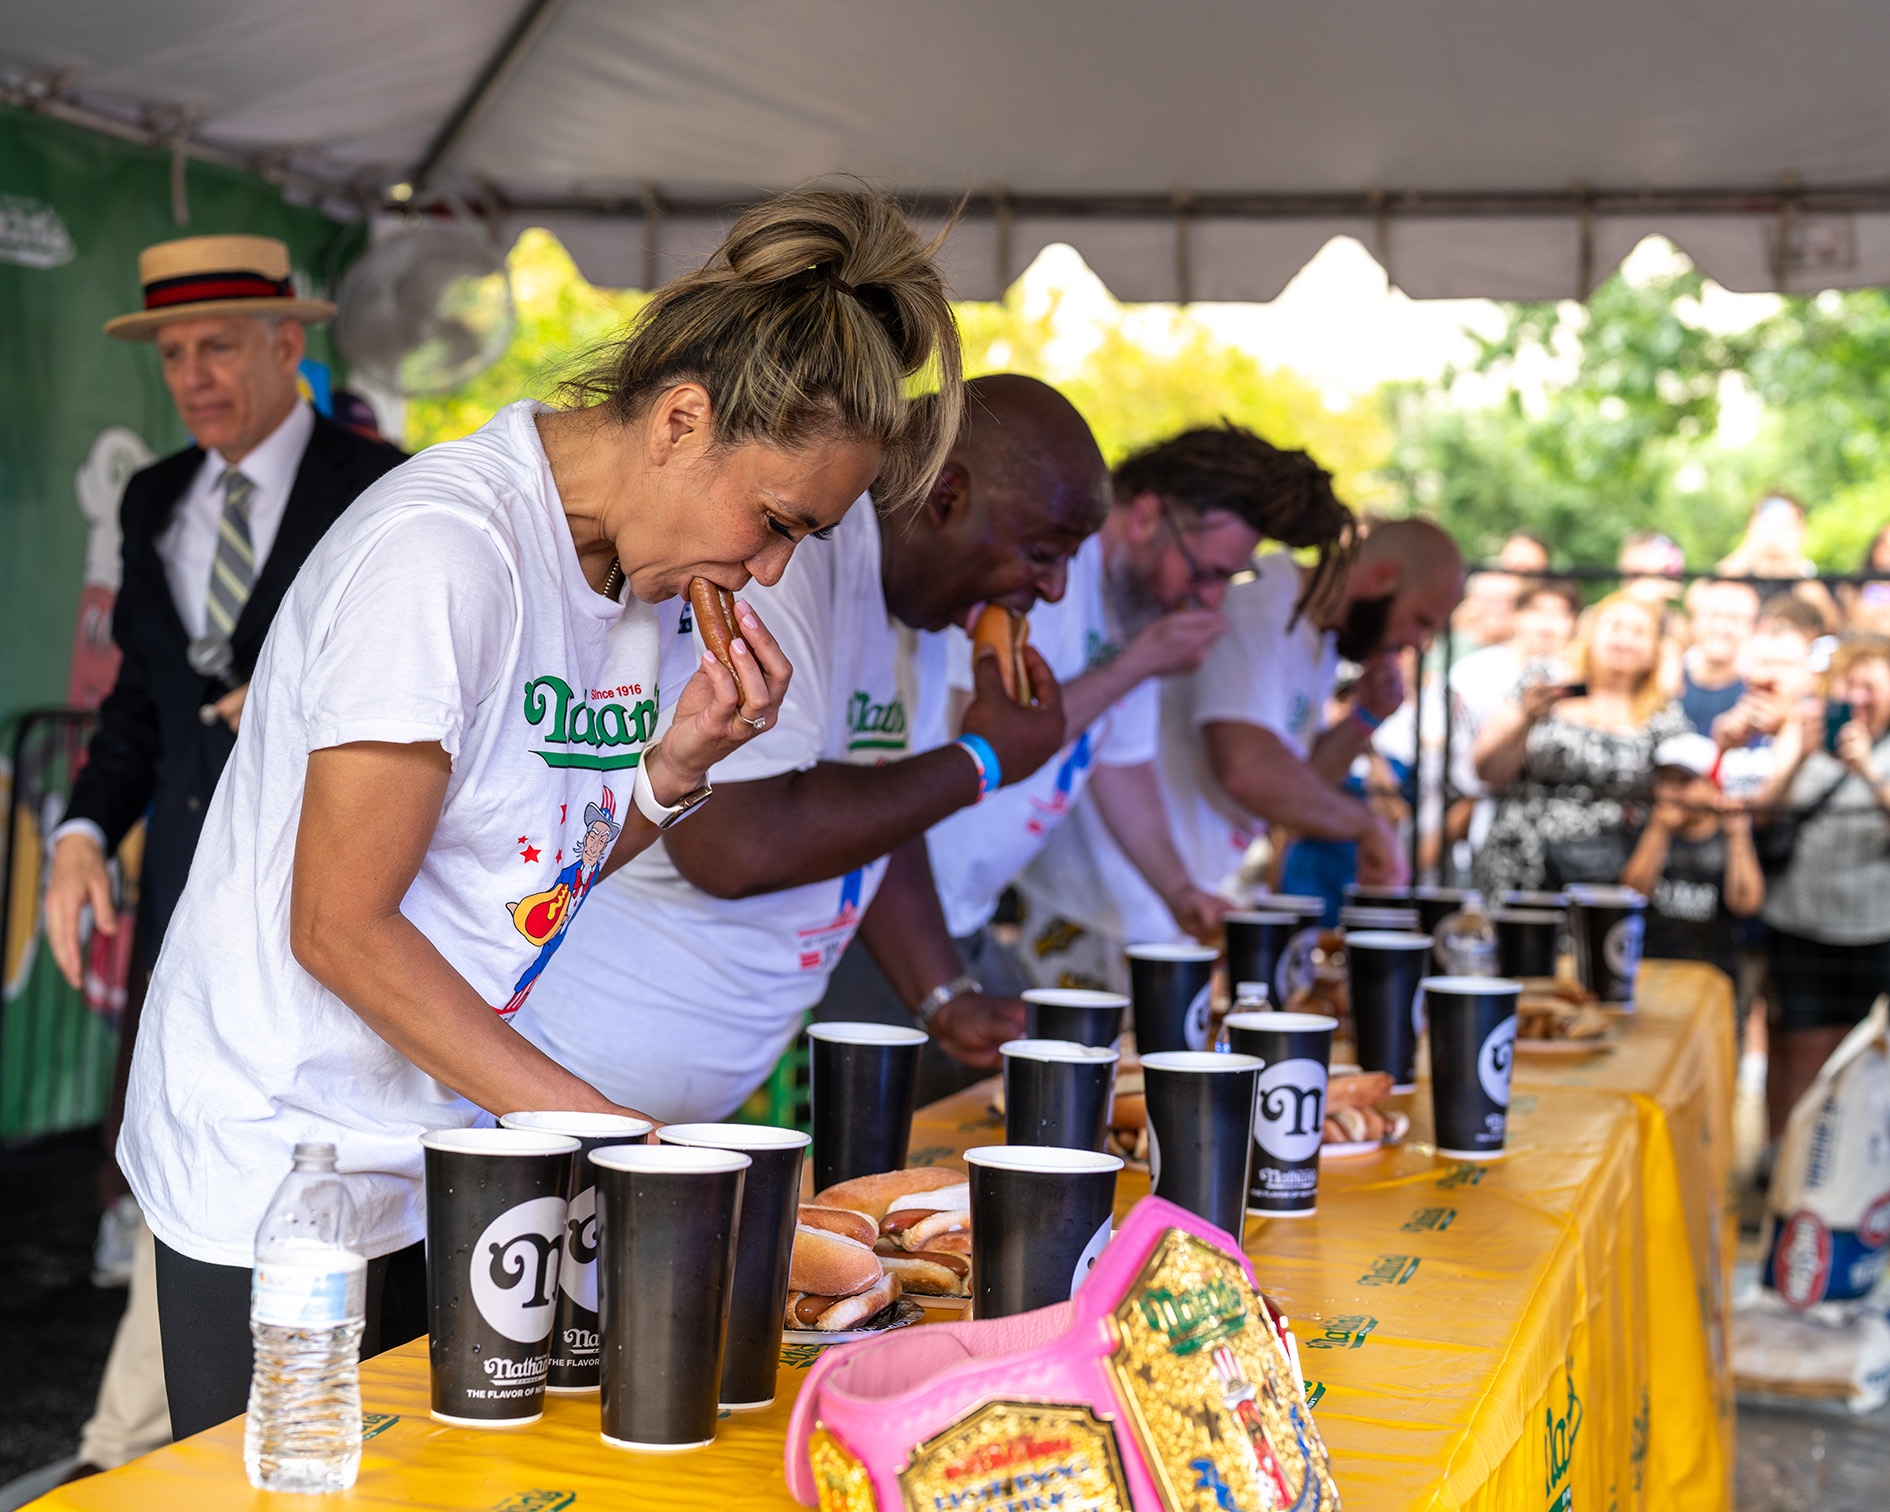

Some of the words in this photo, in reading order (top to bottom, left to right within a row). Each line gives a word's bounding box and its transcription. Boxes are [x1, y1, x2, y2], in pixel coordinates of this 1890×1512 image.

[591, 688, 615, 701] Since
[616, 683, 642, 697] 1916
[548, 1358, 565, 1367] THE
[567, 1358, 600, 1367] FLAVOR
[466, 1389, 486, 1399] THE
[487, 1389, 524, 1399] FLAVOR
[525, 1387, 535, 1397] OF
